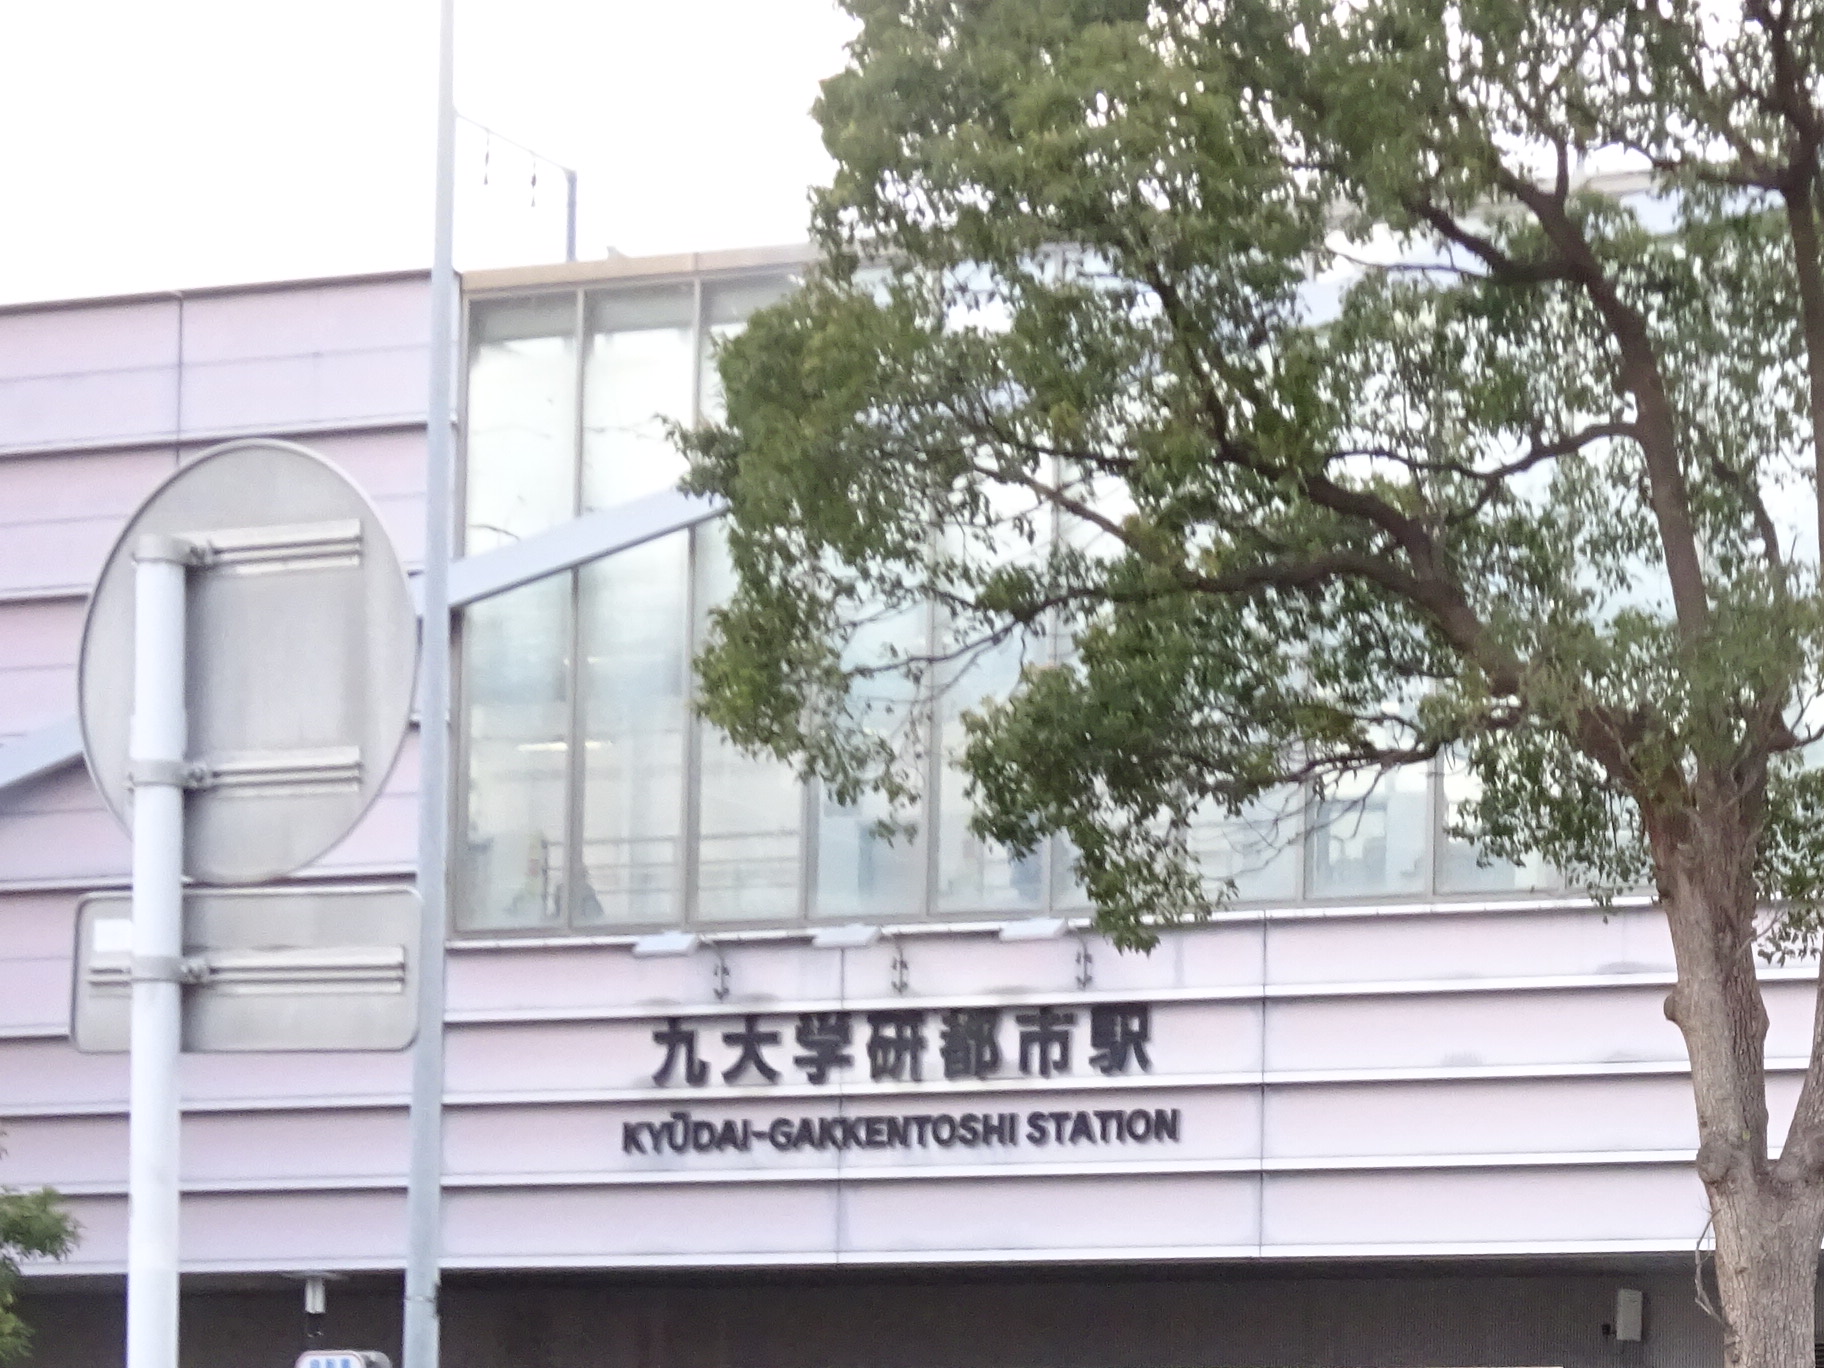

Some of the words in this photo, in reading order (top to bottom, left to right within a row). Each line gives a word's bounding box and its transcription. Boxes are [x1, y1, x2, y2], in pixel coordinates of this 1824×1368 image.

[651, 1001, 1154, 1087] 九大学研都市駅
[622, 1111, 1019, 1155] KYŪDAI-GAKKENTOSHI
[1026, 1107, 1181, 1146] STATION
